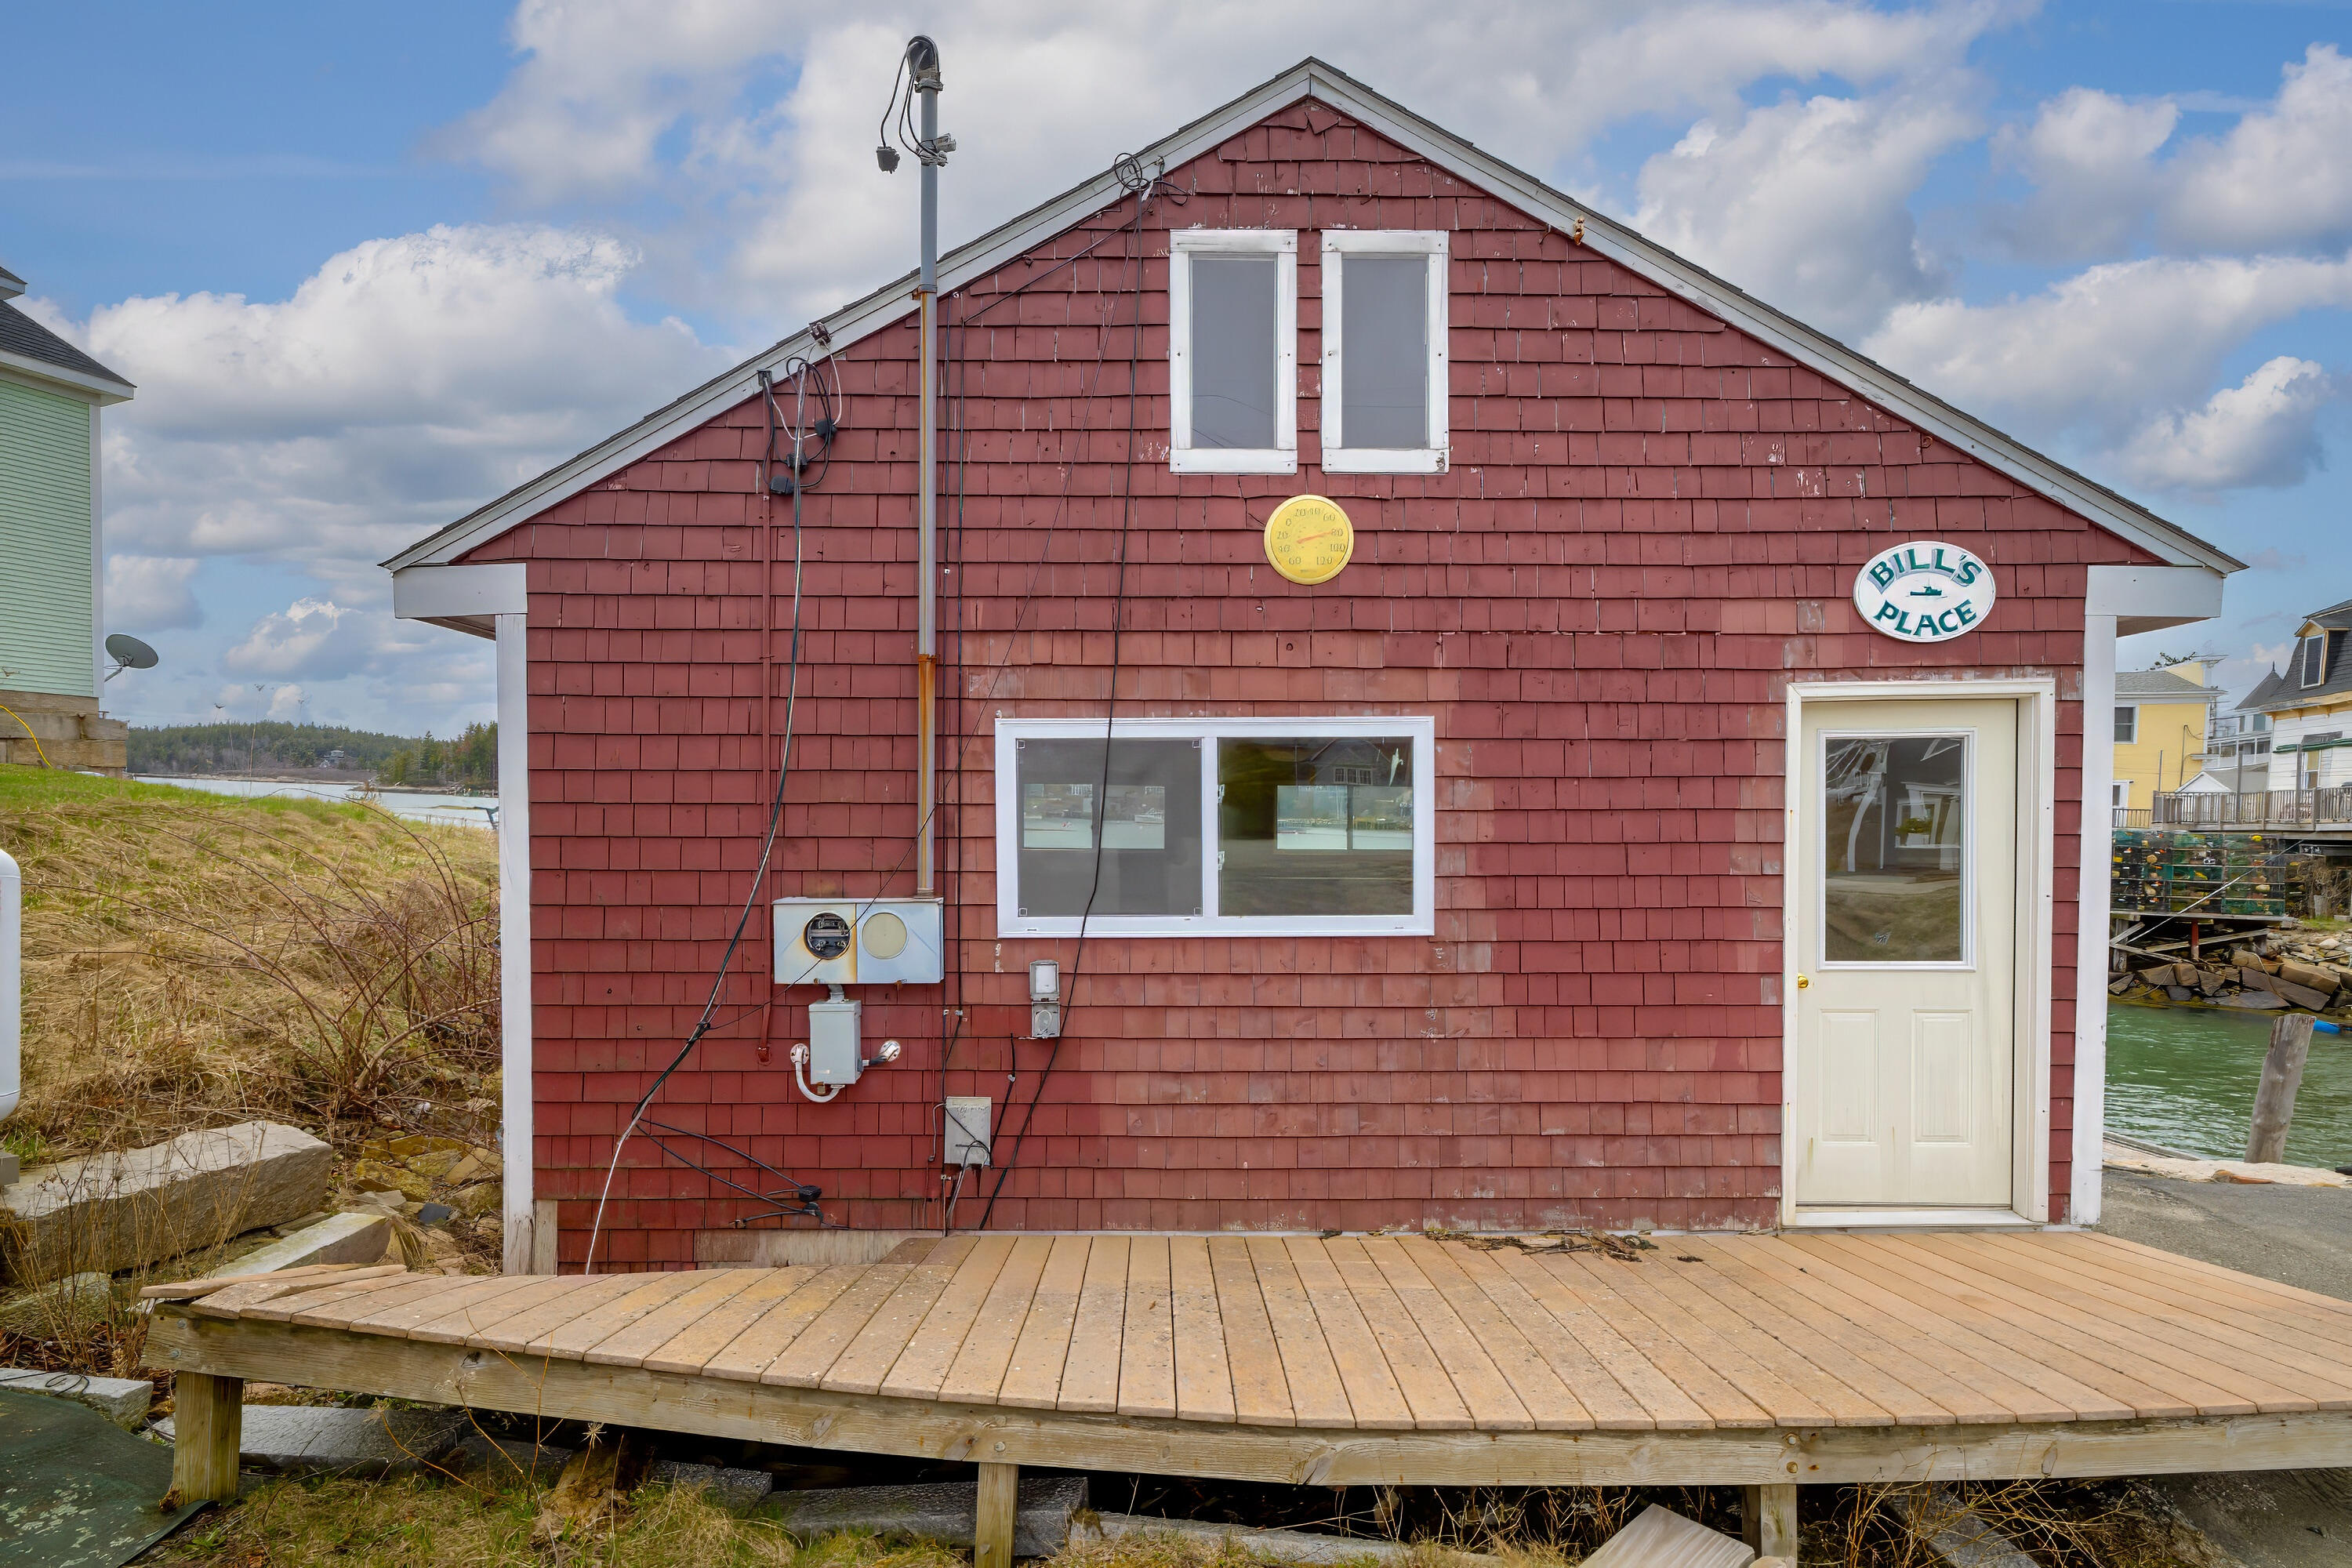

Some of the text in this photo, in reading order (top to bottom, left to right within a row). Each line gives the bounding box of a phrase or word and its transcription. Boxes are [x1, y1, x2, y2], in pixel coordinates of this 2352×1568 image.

[1286, 518, 1292, 527] 0
[1330, 543, 1345, 552] 100
[1868, 548, 1983, 588] BILL'S
[1872, 598, 1977, 637] PLACE
